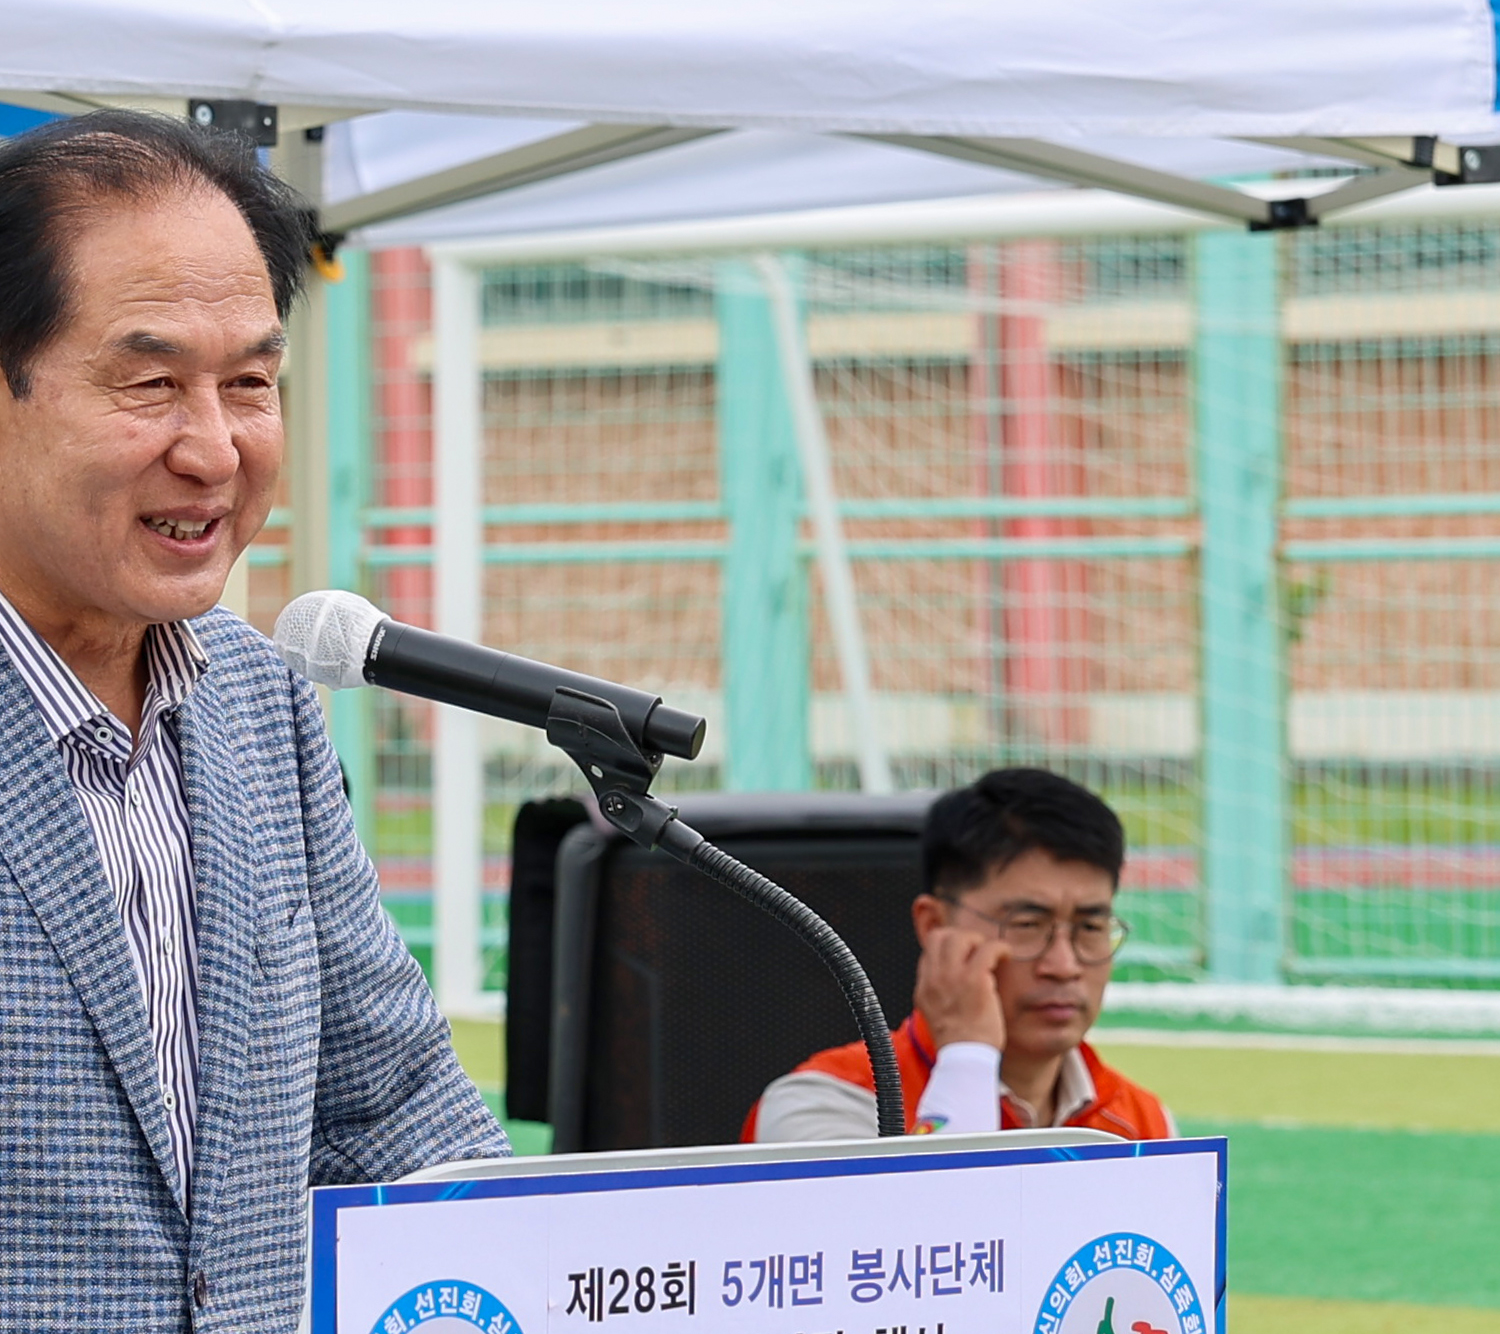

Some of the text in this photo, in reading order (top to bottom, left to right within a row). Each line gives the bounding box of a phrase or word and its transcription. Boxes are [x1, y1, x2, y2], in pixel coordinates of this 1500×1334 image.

[370, 626, 387, 661] SHURE
[565, 1238, 1004, 1323] 제28회 5개면 봉사단체
